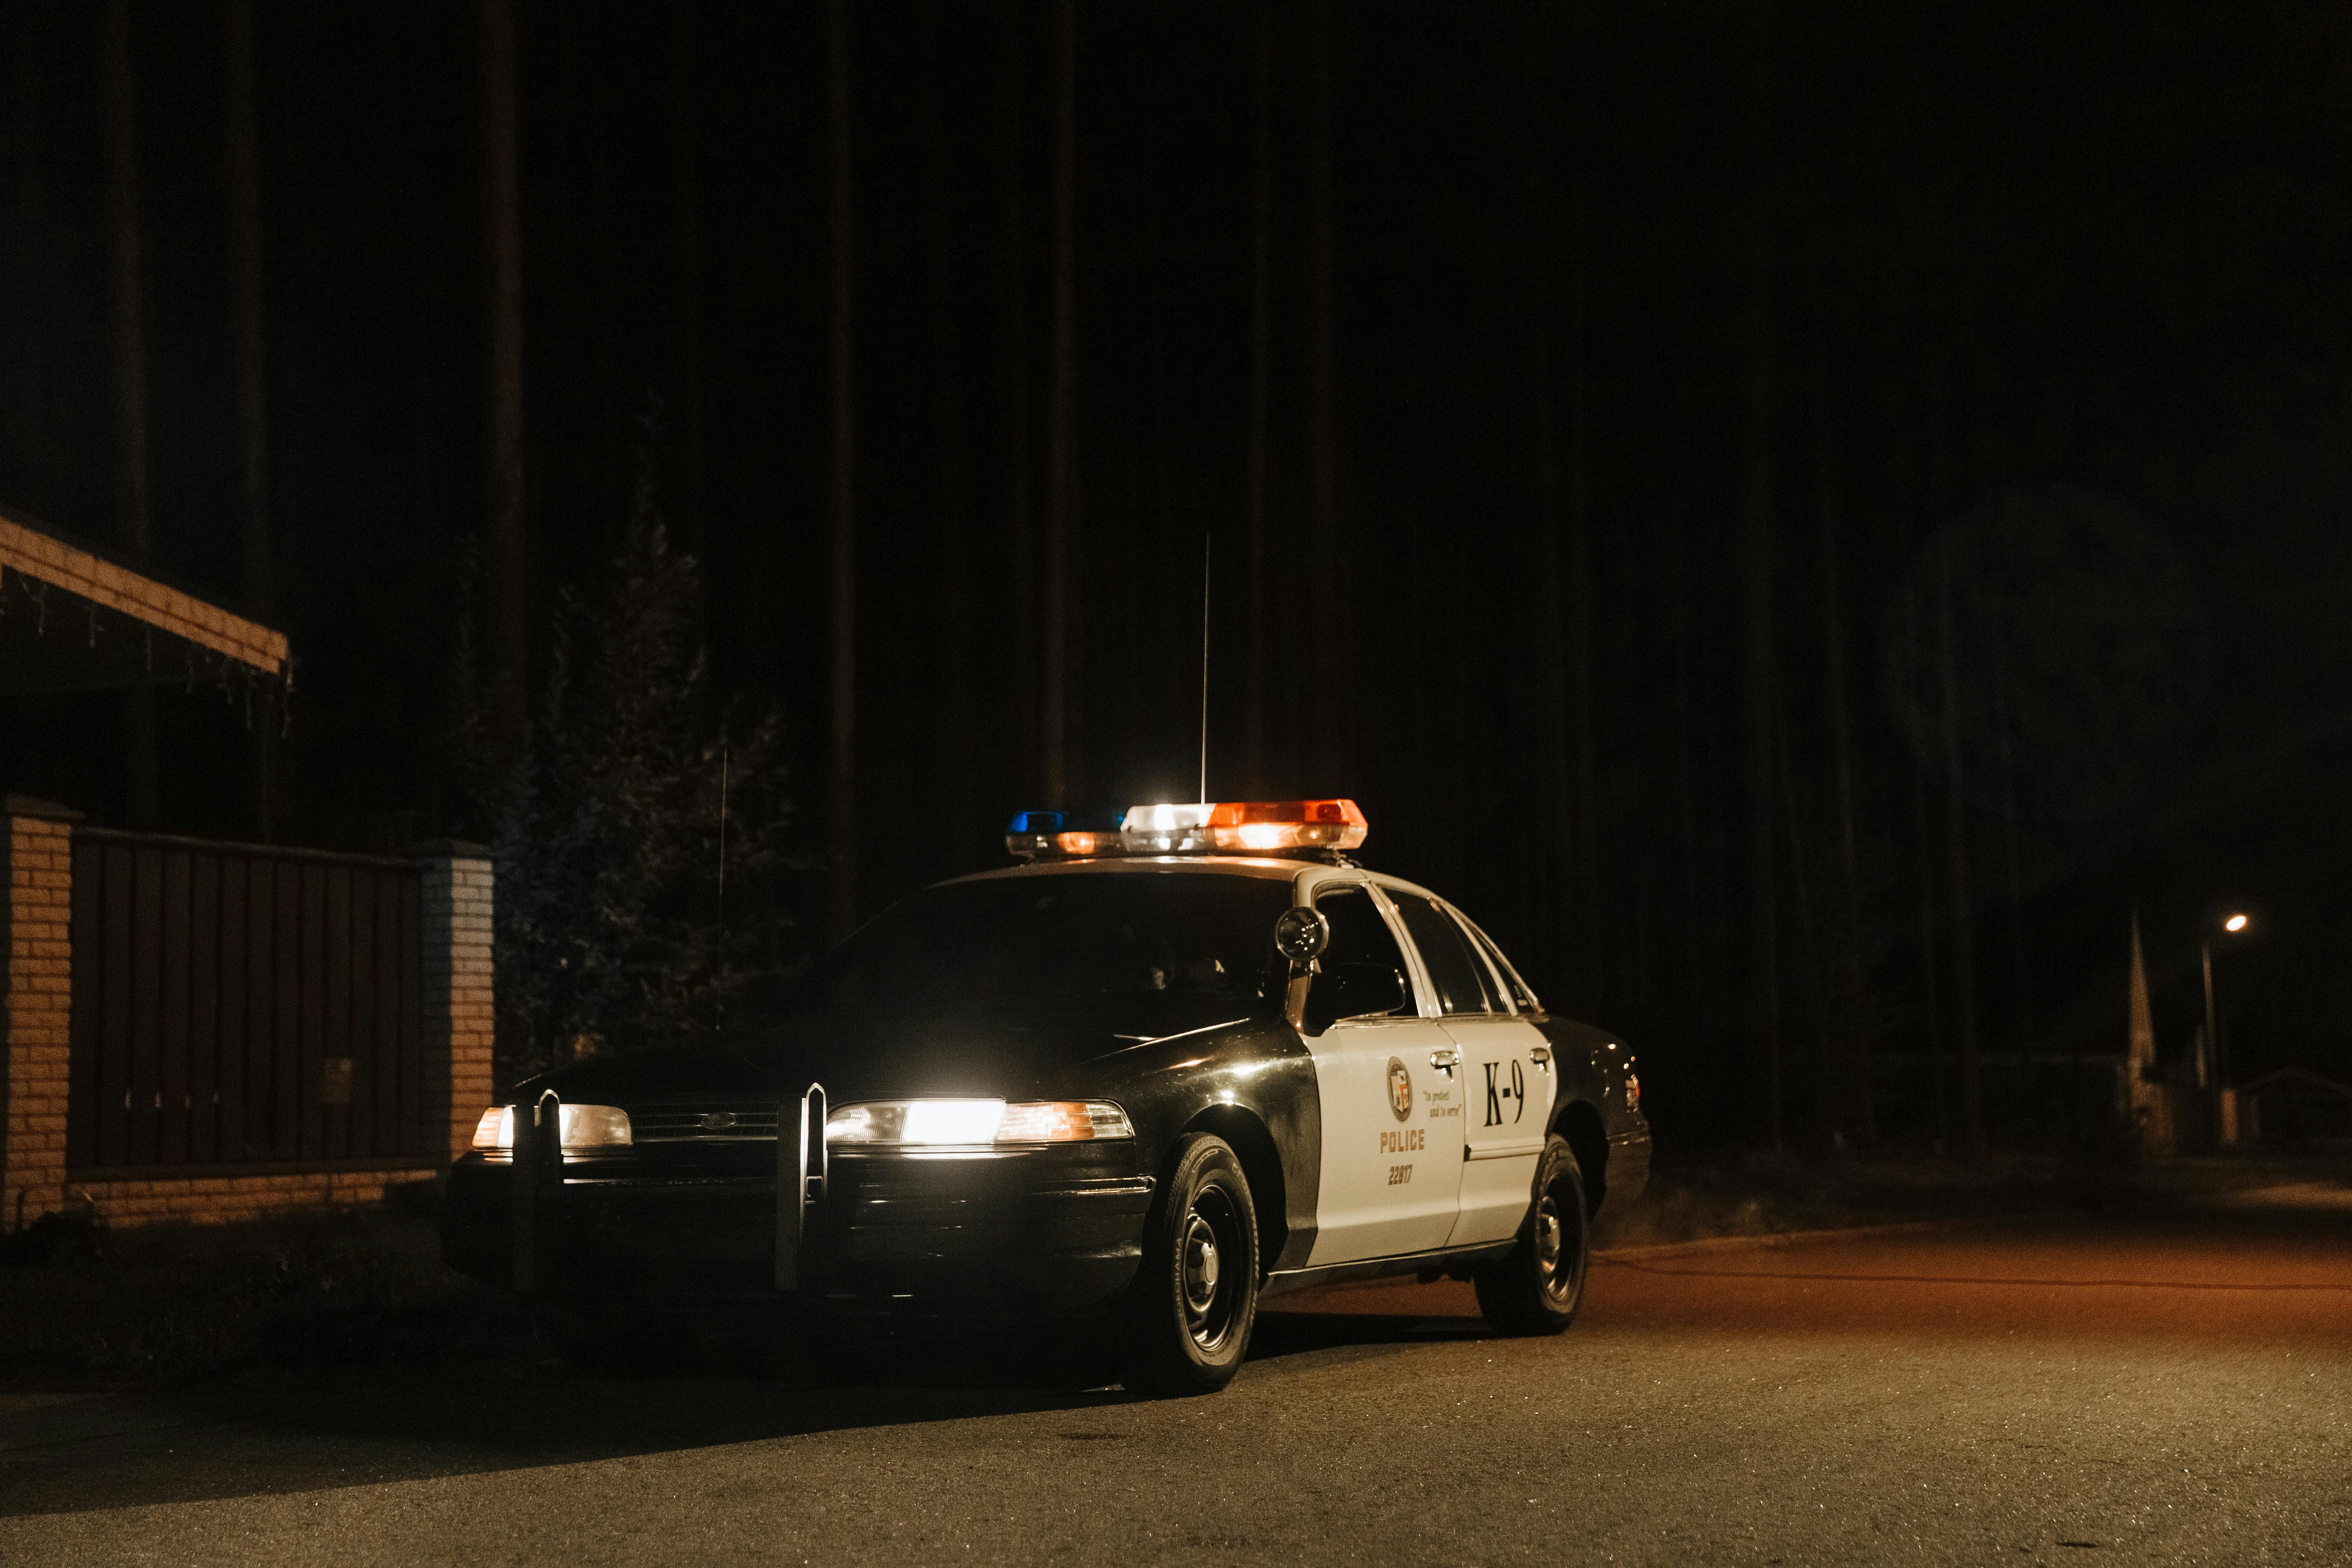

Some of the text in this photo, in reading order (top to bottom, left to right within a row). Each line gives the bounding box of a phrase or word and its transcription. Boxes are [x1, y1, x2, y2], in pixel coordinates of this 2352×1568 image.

[1432, 1091, 1449, 1105] protect
[1482, 1060, 1523, 1126] K-9
[1380, 1129, 1424, 1153] POLICE
